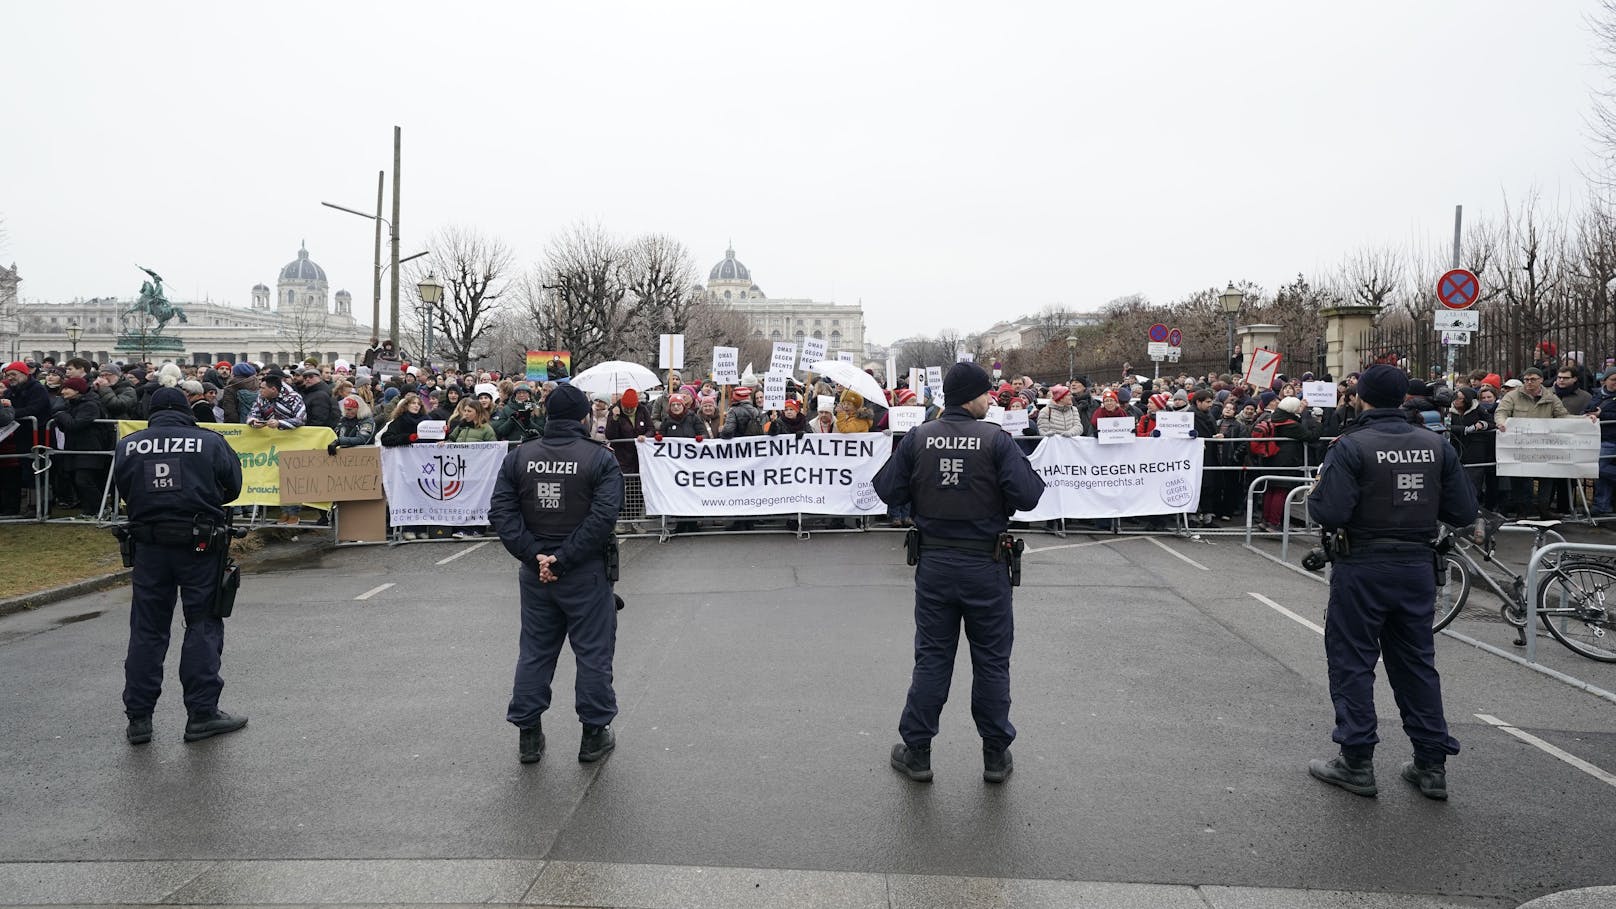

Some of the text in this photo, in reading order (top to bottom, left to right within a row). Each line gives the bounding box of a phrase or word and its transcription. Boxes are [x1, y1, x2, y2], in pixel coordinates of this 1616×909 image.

[771, 362, 793, 370] RECHTS
[126, 438, 203, 455] POLIZEI
[653, 439, 874, 460] ZUSAMMENHALTEN
[926, 436, 981, 450] POLIZEI
[237, 445, 280, 468] mok
[1376, 449, 1435, 463] POLIZEI
[155, 463, 170, 477] D
[527, 461, 578, 475] POLIZEI
[940, 458, 963, 473] BE
[1091, 463, 1135, 476] GEGEN
[1139, 460, 1191, 473] RECHTS
[152, 478, 174, 488] 151
[674, 466, 853, 487] GEGEN RECHTS
[941, 473, 959, 486] 24
[1397, 474, 1424, 489] BE
[327, 475, 378, 493] DANKE!
[537, 482, 561, 497] BE
[857, 481, 873, 489] OMA
[701, 493, 825, 507] www.omasgegenrechts.at
[1403, 491, 1418, 501] 24
[540, 499, 559, 509] 120
